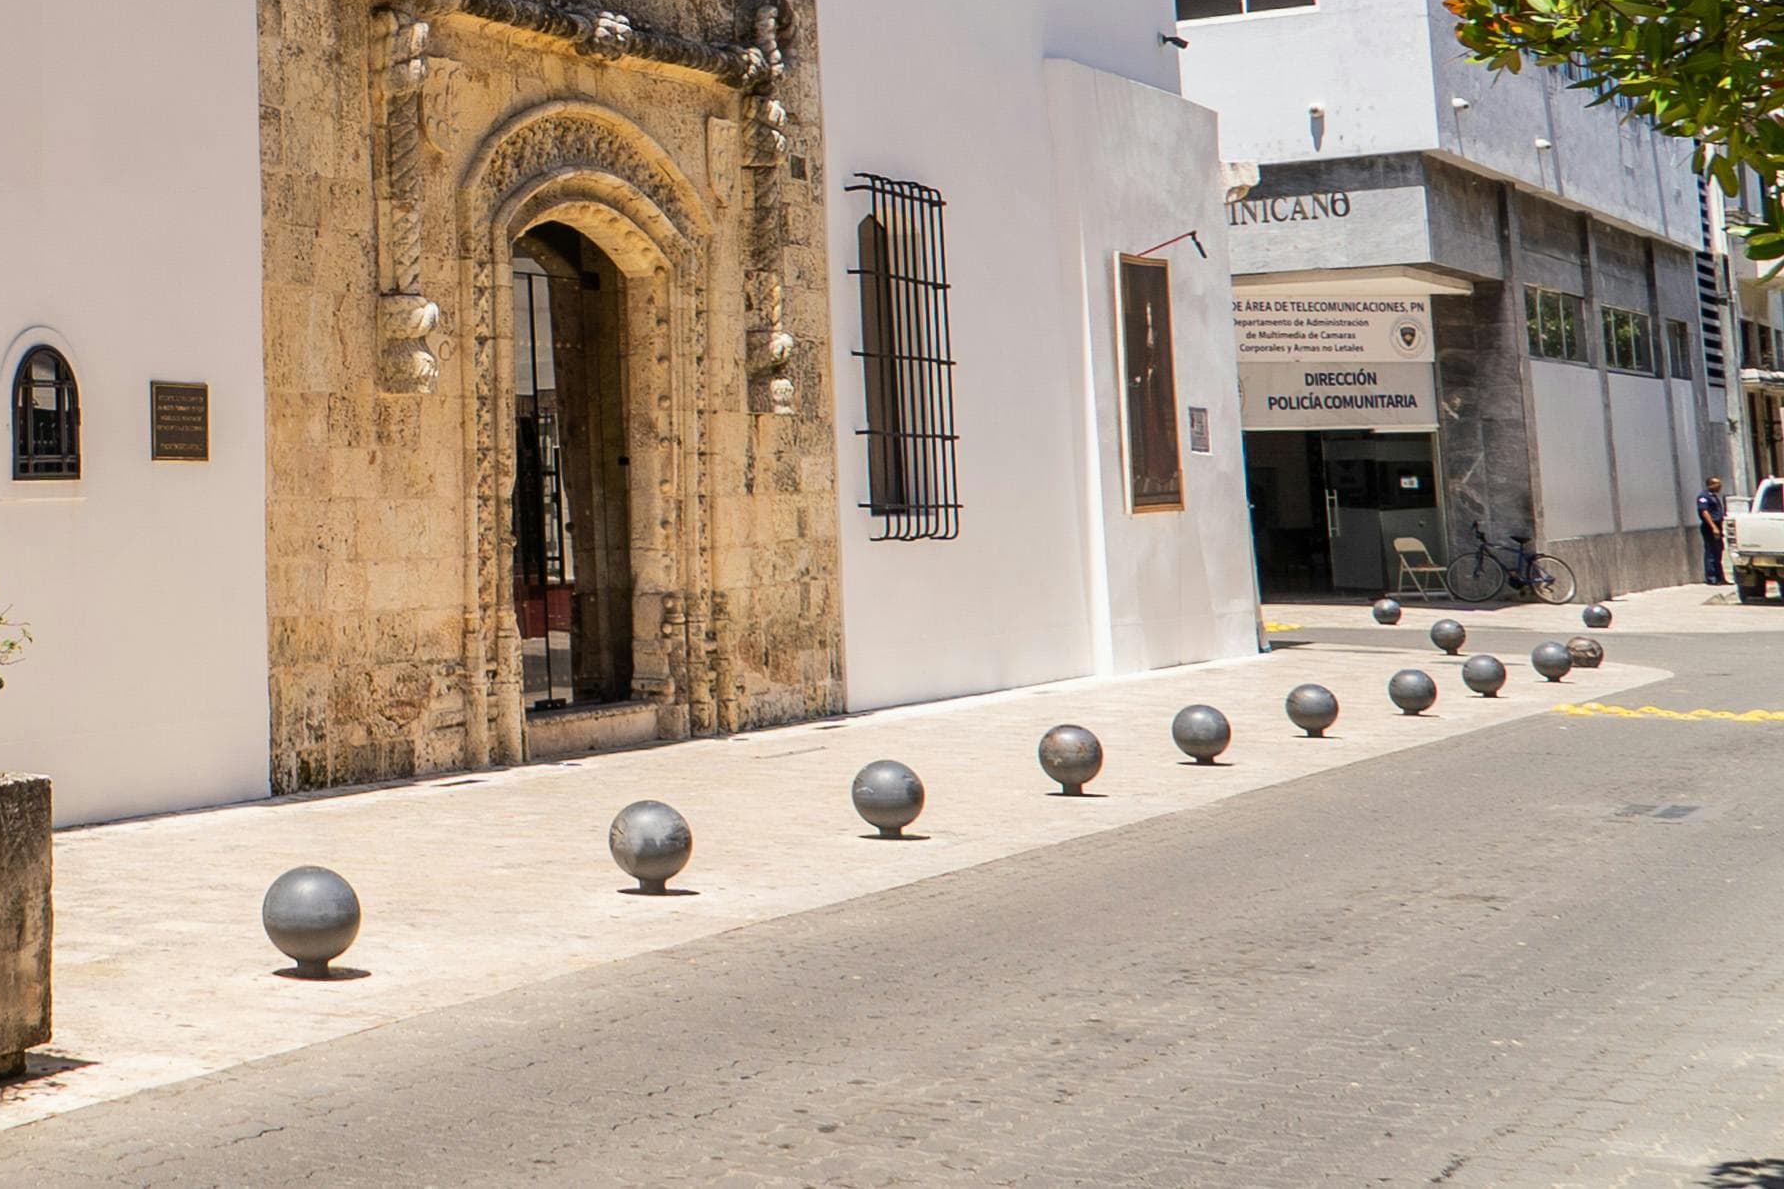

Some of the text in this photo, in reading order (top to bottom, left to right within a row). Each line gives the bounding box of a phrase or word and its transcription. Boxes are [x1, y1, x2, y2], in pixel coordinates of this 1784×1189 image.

[1245, 298, 1272, 312] ÁREA
[1275, 301, 1289, 312] DE
[1290, 301, 1408, 313] TELECOMUNICACIONES,
[1410, 301, 1425, 312] PN
[1294, 318, 1304, 326] de
[1246, 331, 1256, 339] de
[1259, 331, 1306, 339] Multimedia
[1308, 331, 1318, 339] de
[1239, 343, 1284, 353] Corporales
[1294, 343, 1320, 352] Armas
[1335, 344, 1364, 352] Letales
[1305, 368, 1377, 386] DIRECCIÓN
[1268, 392, 1417, 410] POLICÍA COMUNITARIA
